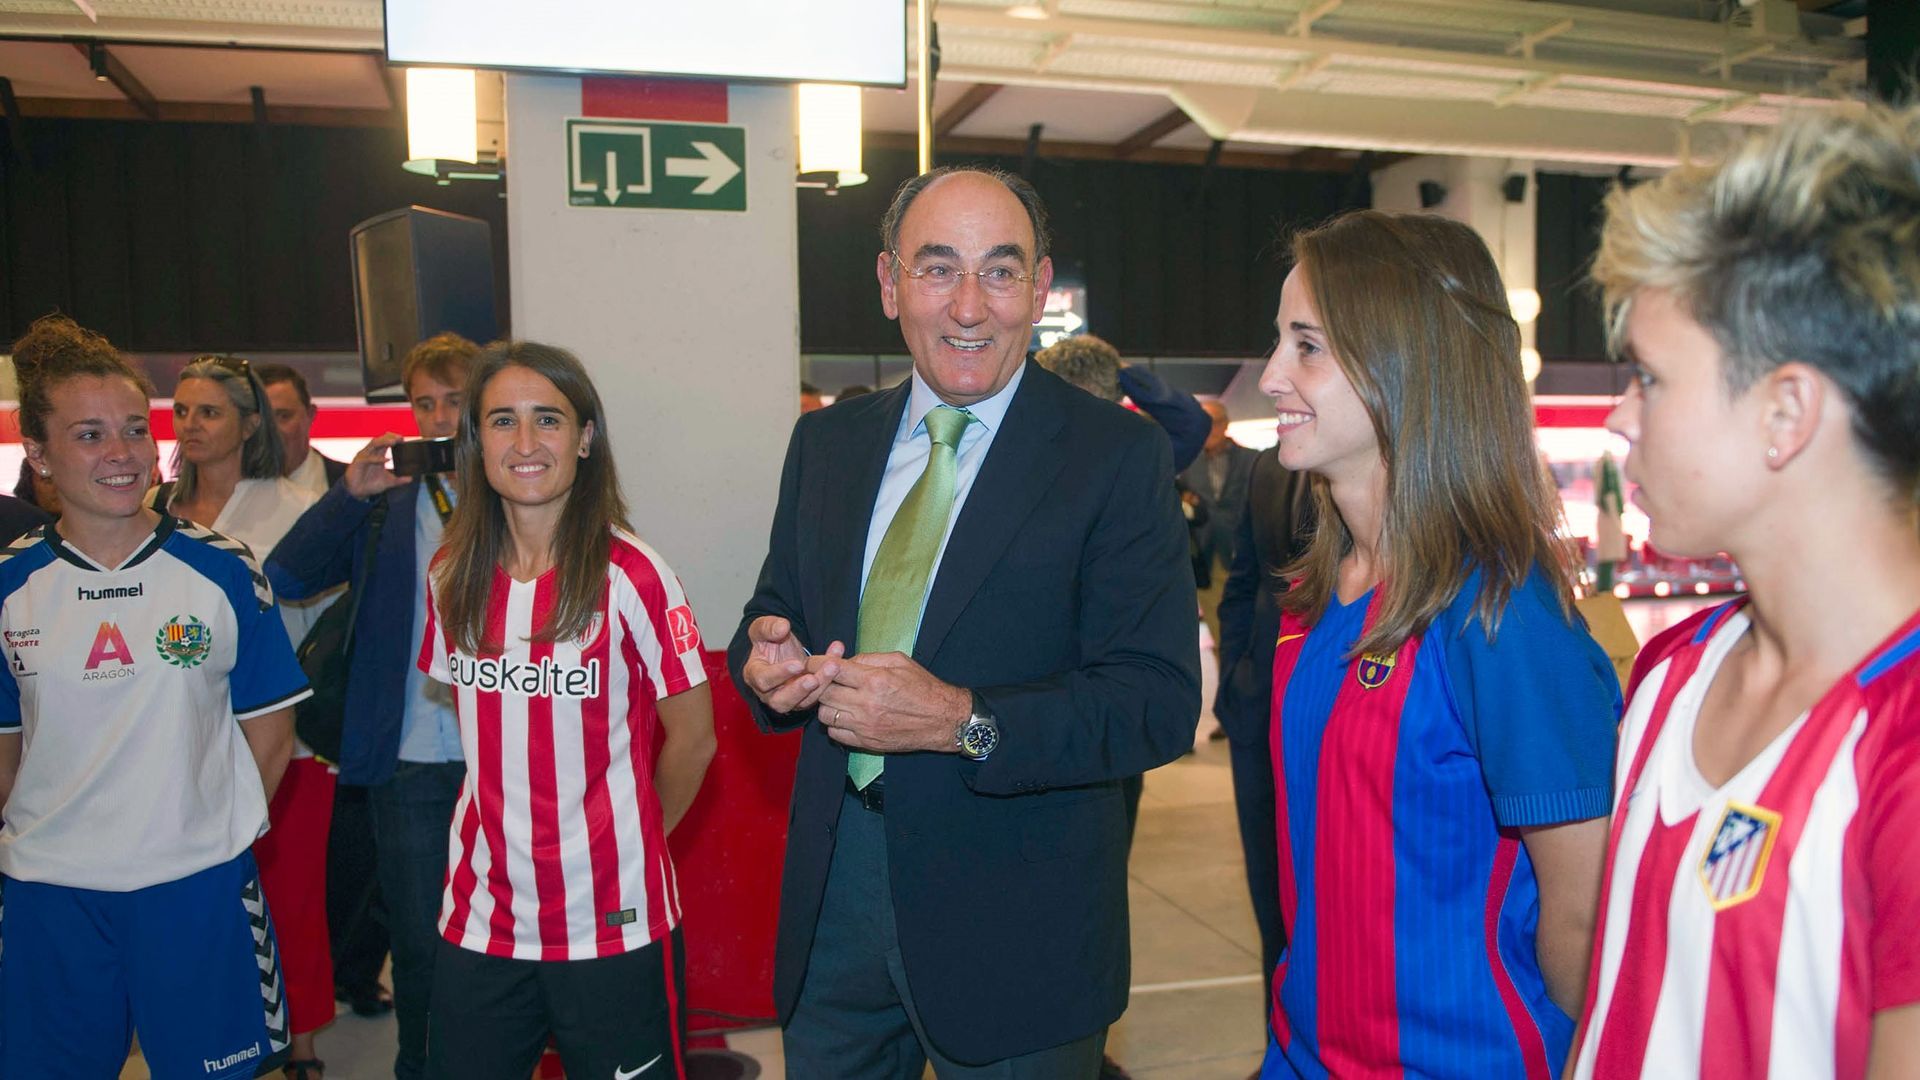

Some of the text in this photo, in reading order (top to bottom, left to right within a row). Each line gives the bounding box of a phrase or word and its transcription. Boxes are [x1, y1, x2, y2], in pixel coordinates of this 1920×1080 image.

[78, 582, 143, 600] hummel
[82, 668, 135, 681] ARAGÓN
[450, 656, 596, 695] euskaltel
[204, 1041, 260, 1073] hummel
